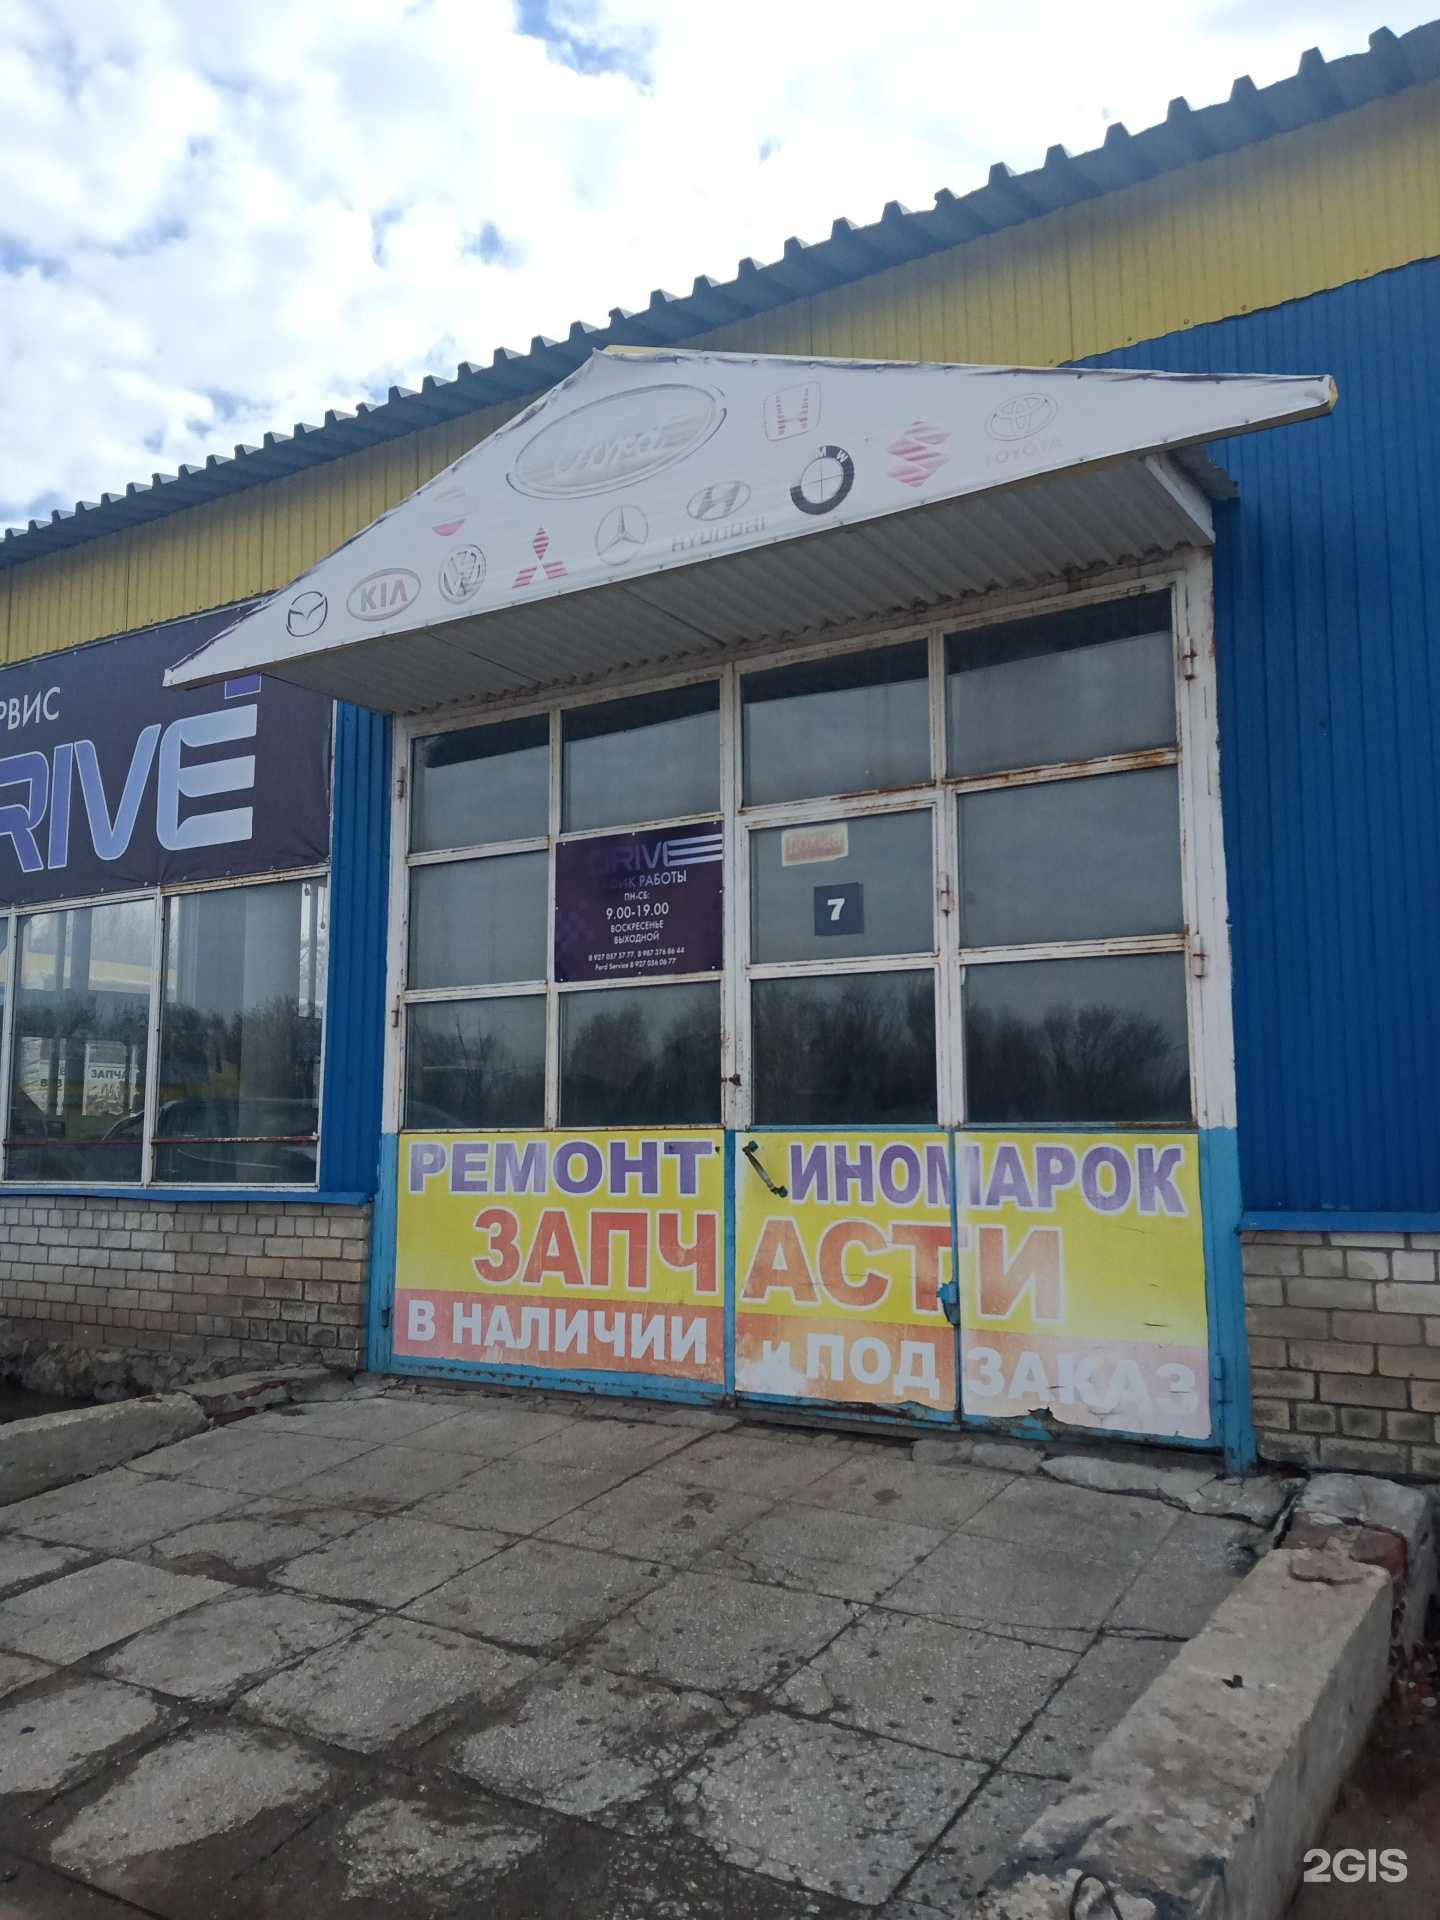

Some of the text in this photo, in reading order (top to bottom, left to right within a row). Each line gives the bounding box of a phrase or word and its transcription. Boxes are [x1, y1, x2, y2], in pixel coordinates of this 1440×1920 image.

[639, 871, 687, 888] РАБОТЫ
[605, 902, 670, 920] 9.00-19.00
[827, 897, 845, 921] 7
[610, 919, 665, 933] ВОСКРЕСЕНЬЕ
[613, 931, 660, 945] ВЫХОДНОЙ
[409, 1140, 1189, 1216] РЕМОНТ ИНОМАРОК
[407, 1300, 437, 1342] В
[452, 1302, 708, 1365] НАЛИЧИИ
[805, 1333, 941, 1400] ПОД
[966, 1347, 1199, 1415] ЗАКАЗ
